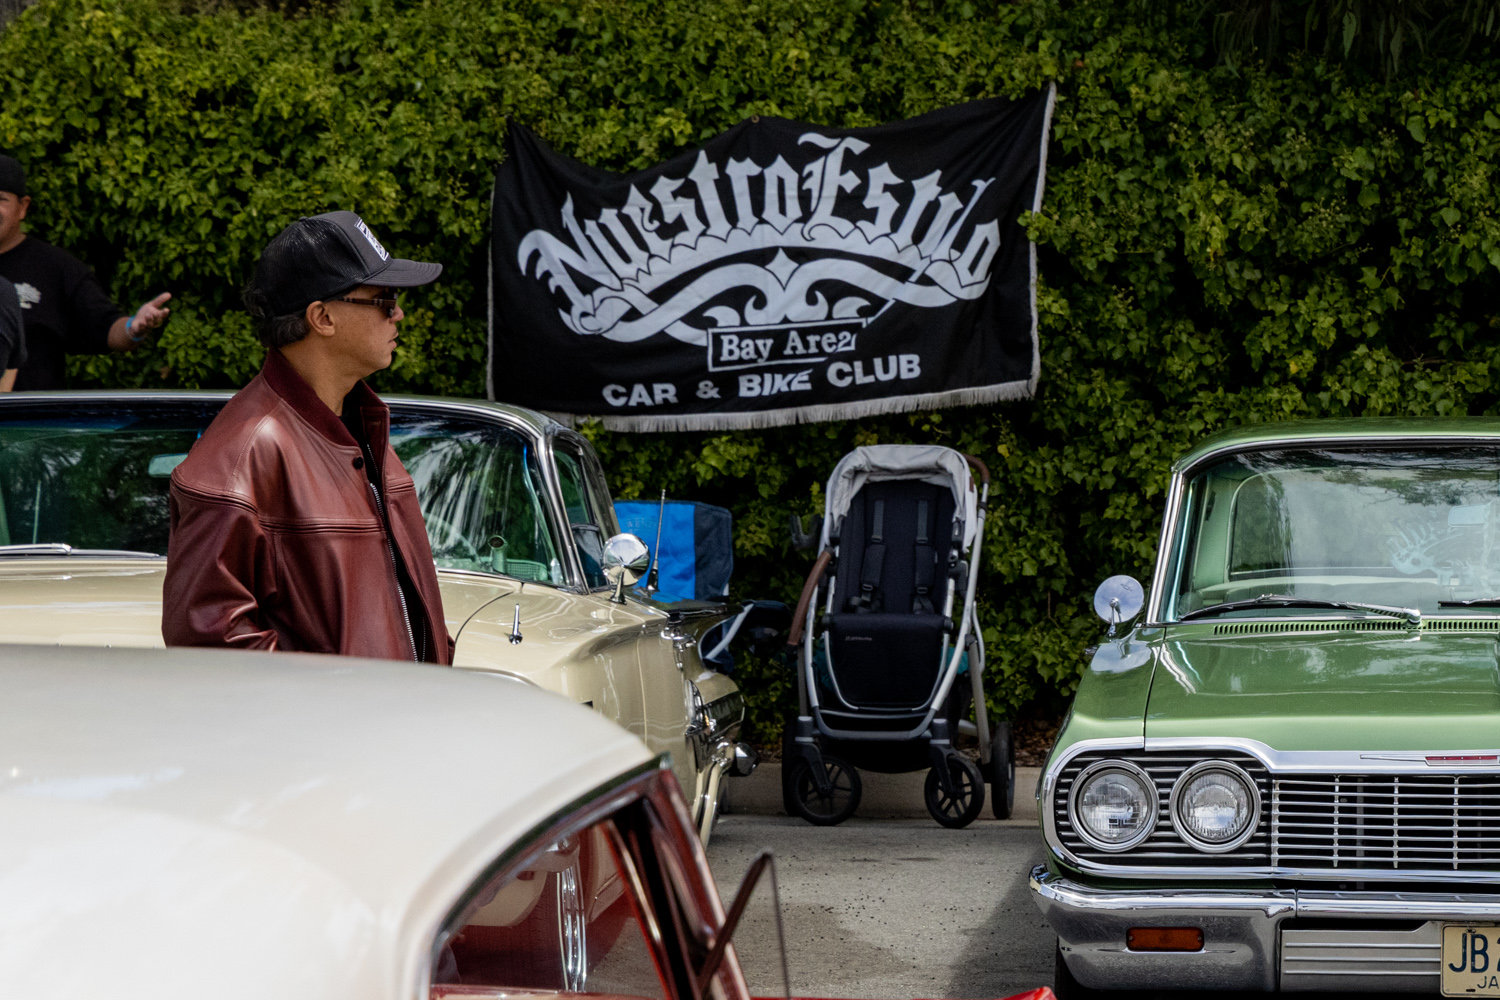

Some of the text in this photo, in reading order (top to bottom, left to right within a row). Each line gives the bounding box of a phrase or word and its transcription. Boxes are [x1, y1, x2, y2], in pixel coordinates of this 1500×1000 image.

[720, 334, 774, 364] Bay
[602, 354, 921, 407] CAR & BIKE CLUB
